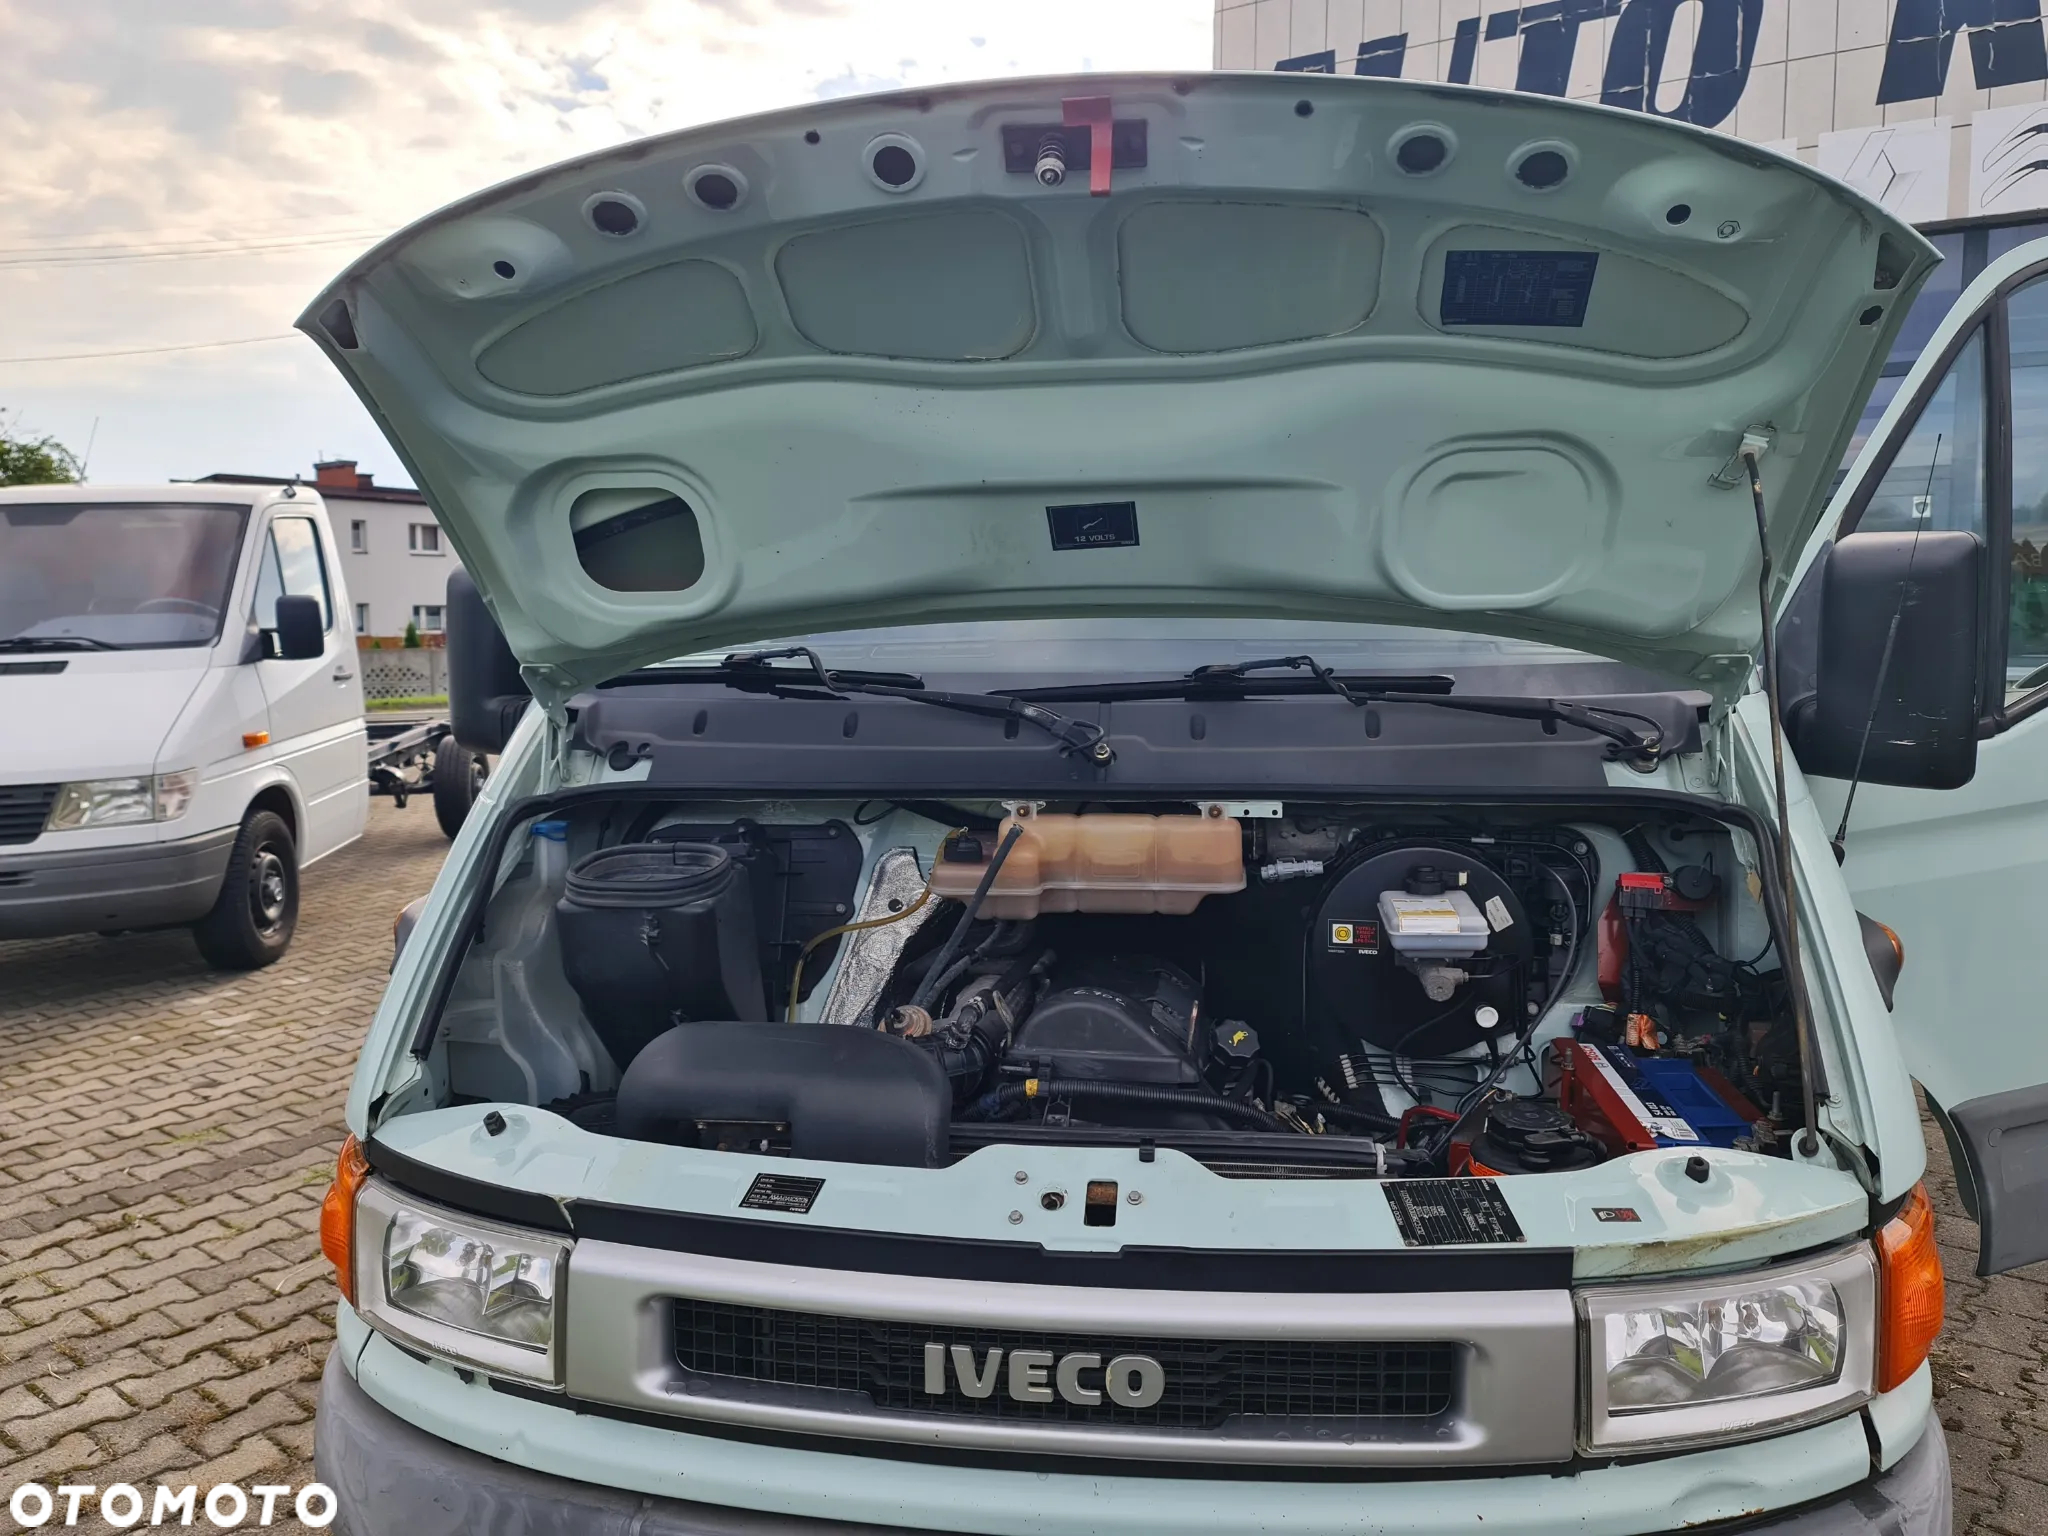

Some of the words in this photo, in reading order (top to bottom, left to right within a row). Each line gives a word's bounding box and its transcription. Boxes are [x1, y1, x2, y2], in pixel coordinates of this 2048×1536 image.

[1074, 535, 1087, 543] 12
[1089, 533, 1116, 542] VOLTS
[924, 1342, 1165, 1408] IVECO
